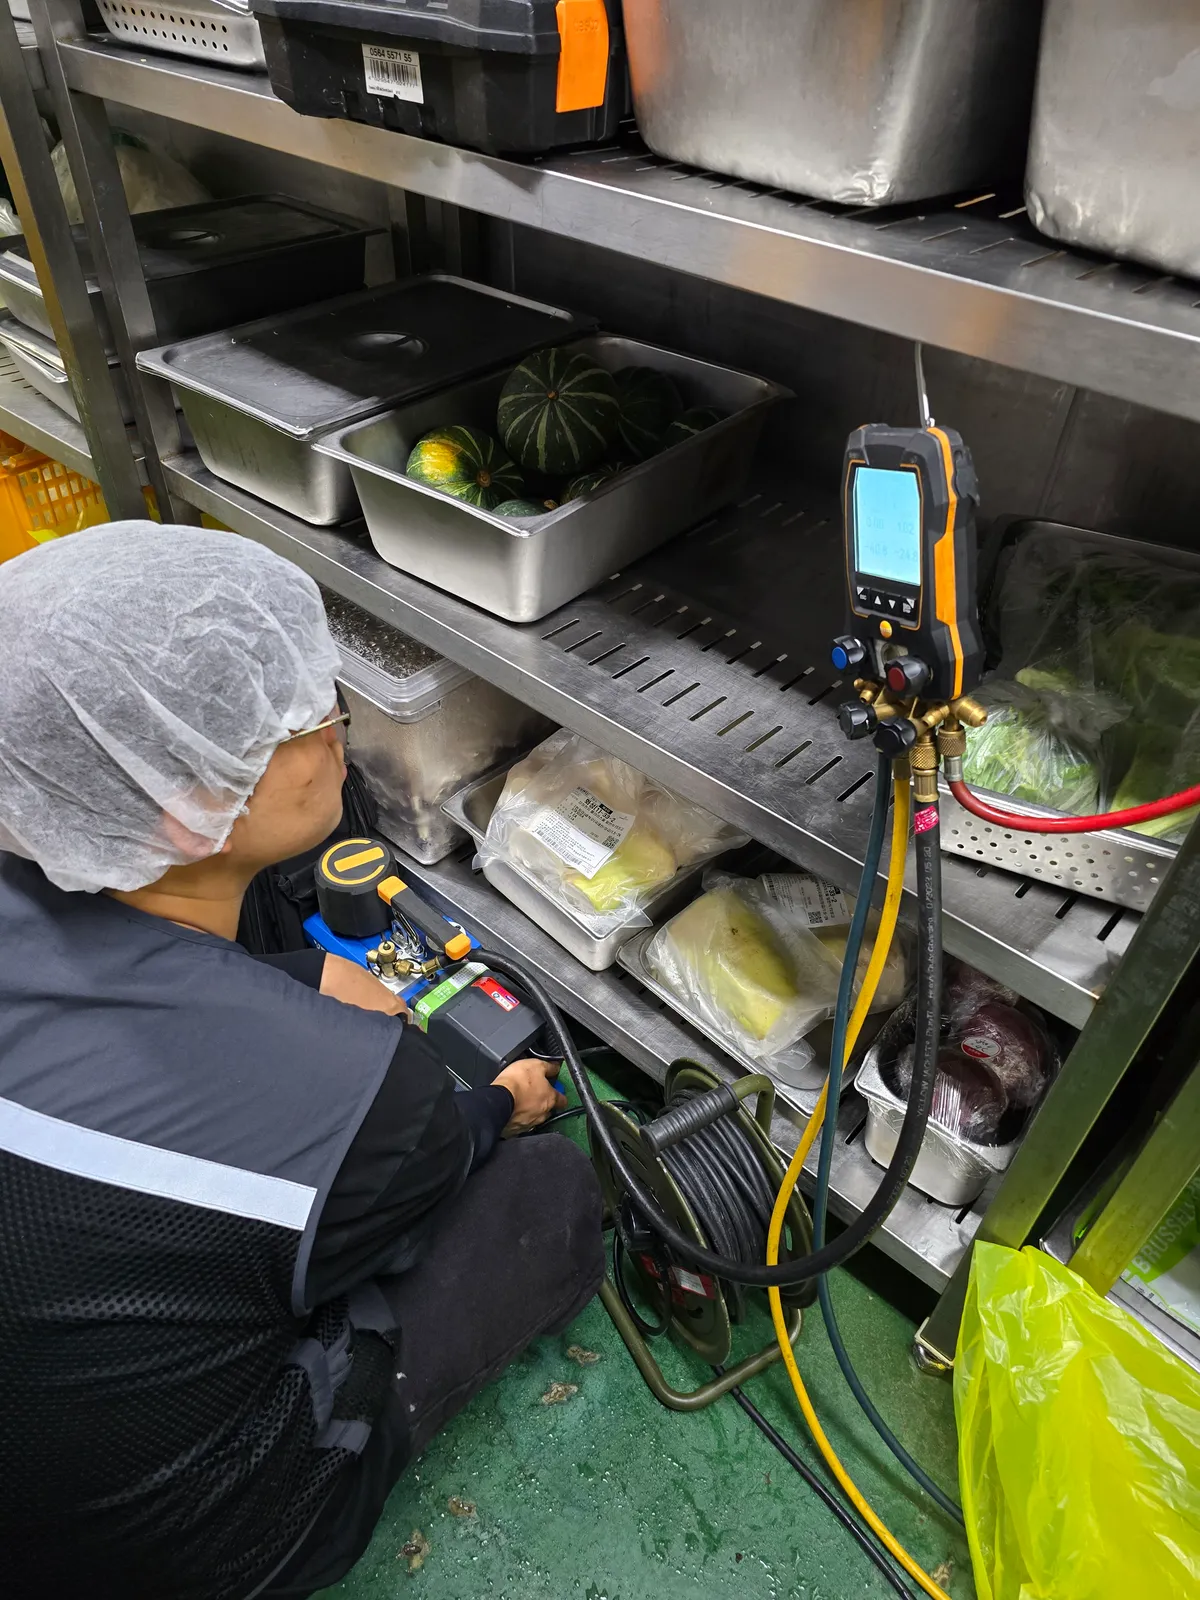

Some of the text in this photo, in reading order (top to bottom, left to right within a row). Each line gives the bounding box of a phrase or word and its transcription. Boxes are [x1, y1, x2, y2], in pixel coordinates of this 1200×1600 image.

[370, 47, 412, 62] 0564 5571 55
